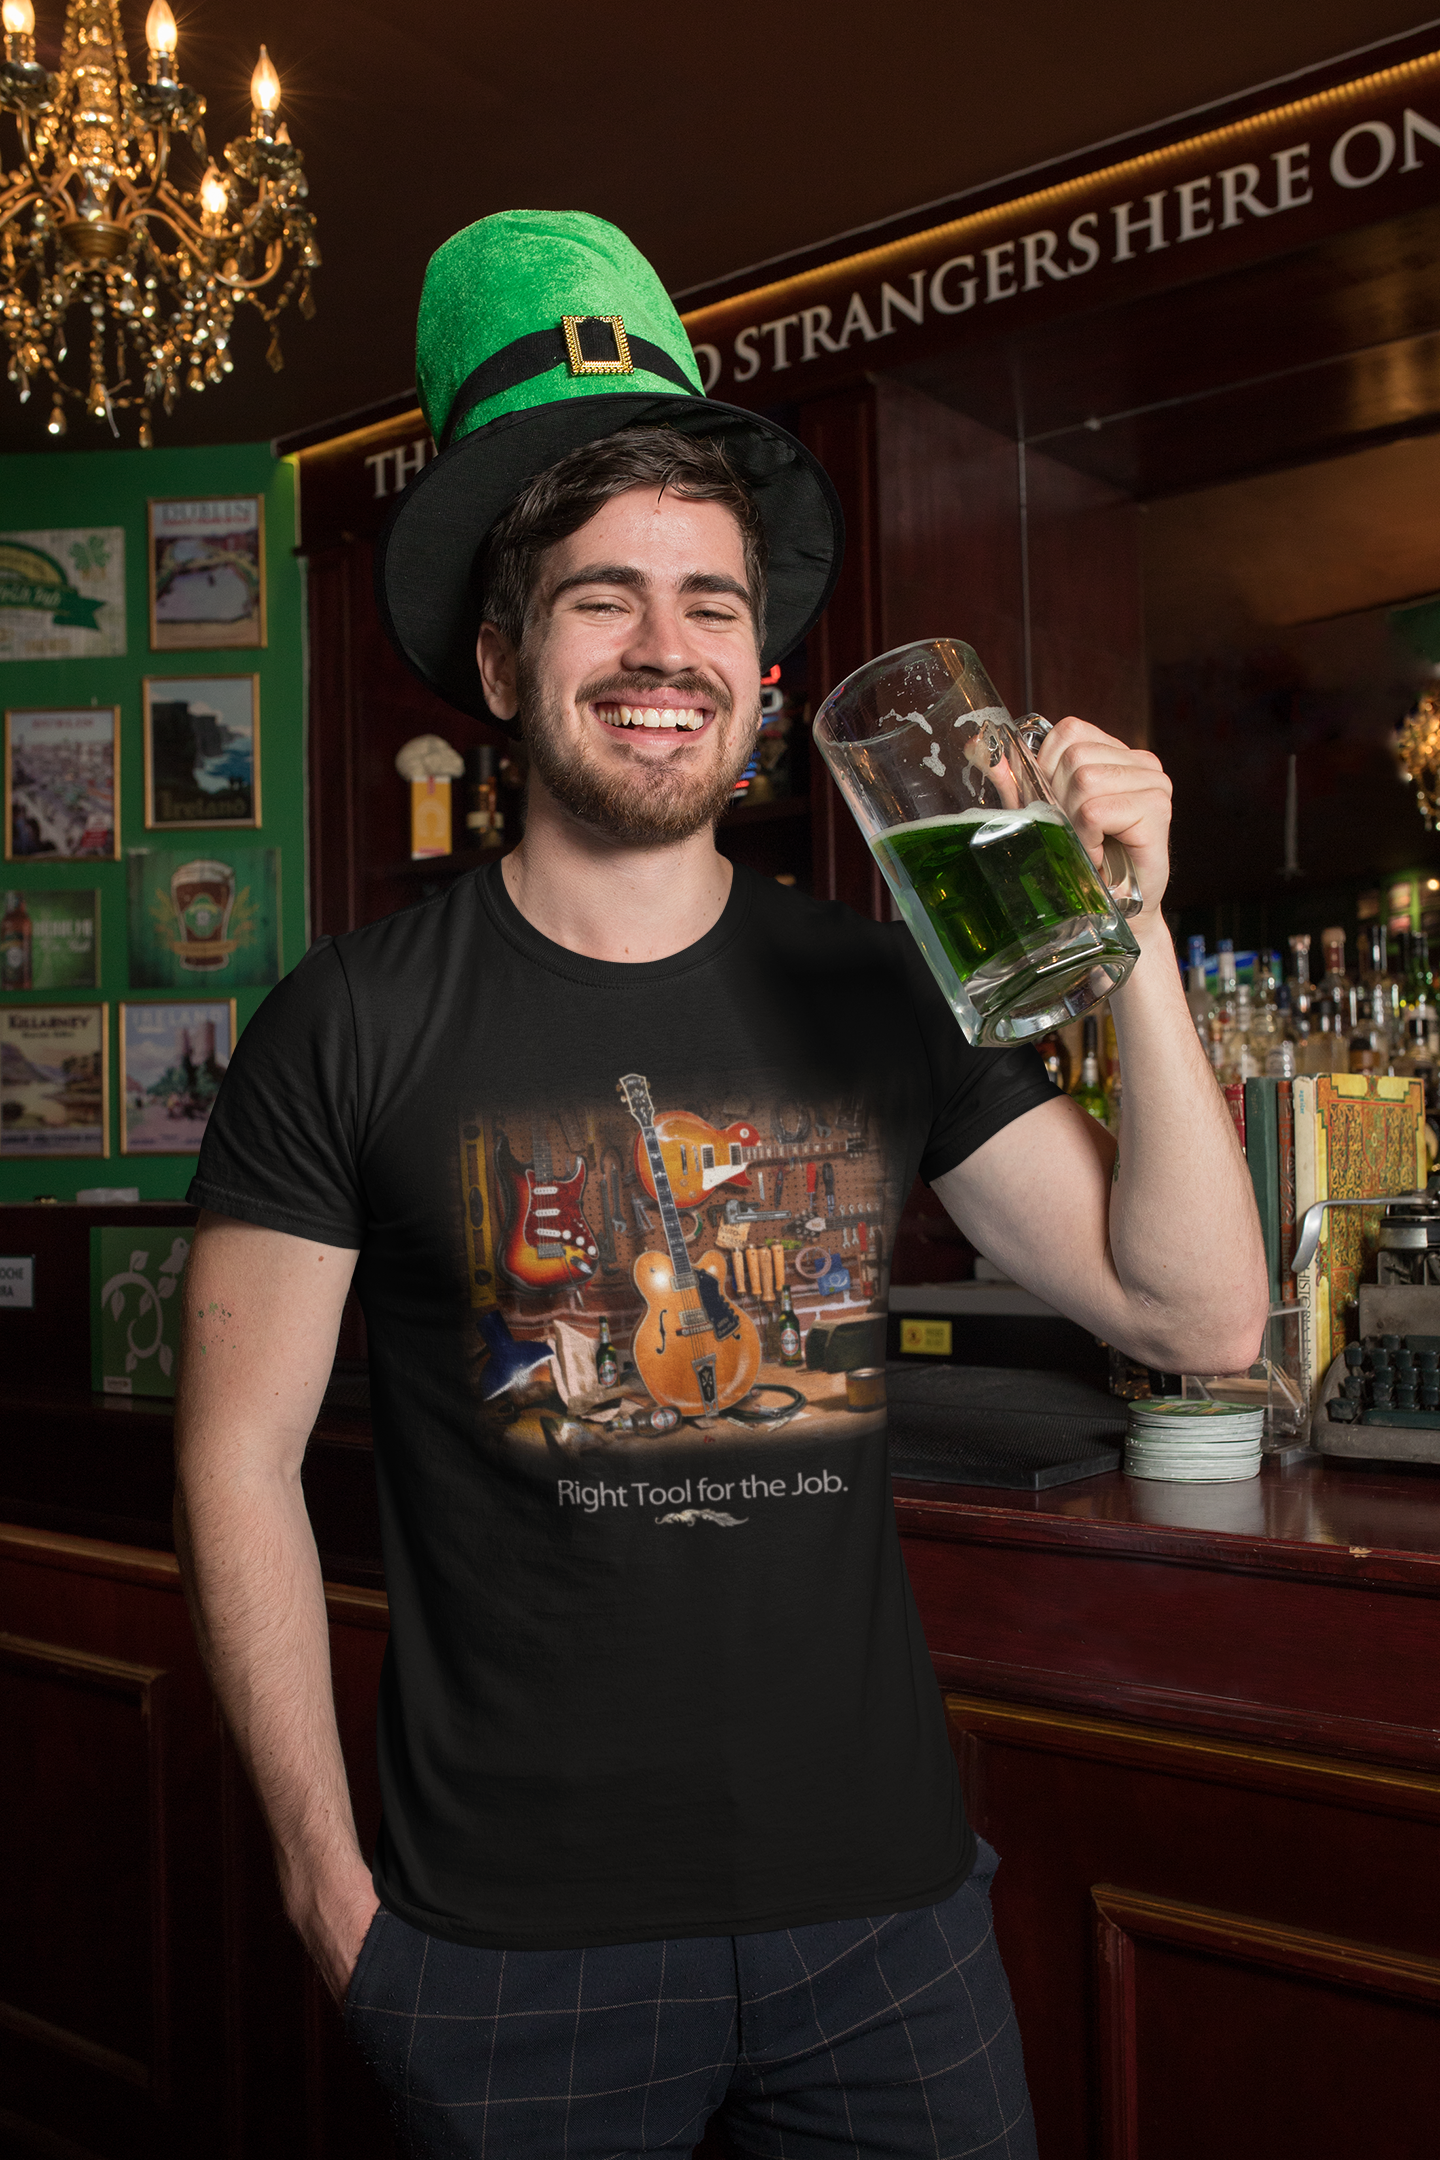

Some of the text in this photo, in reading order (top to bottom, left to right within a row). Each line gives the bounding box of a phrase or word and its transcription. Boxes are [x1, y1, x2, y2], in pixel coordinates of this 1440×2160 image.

[364, 436, 439, 499] TH
[733, 212, 1101, 382] STRANGERS
[1109, 142, 1314, 263] HERE
[1329, 107, 1440, 189] ON
[557, 1469, 849, 1513] Right Tool for the Job.
